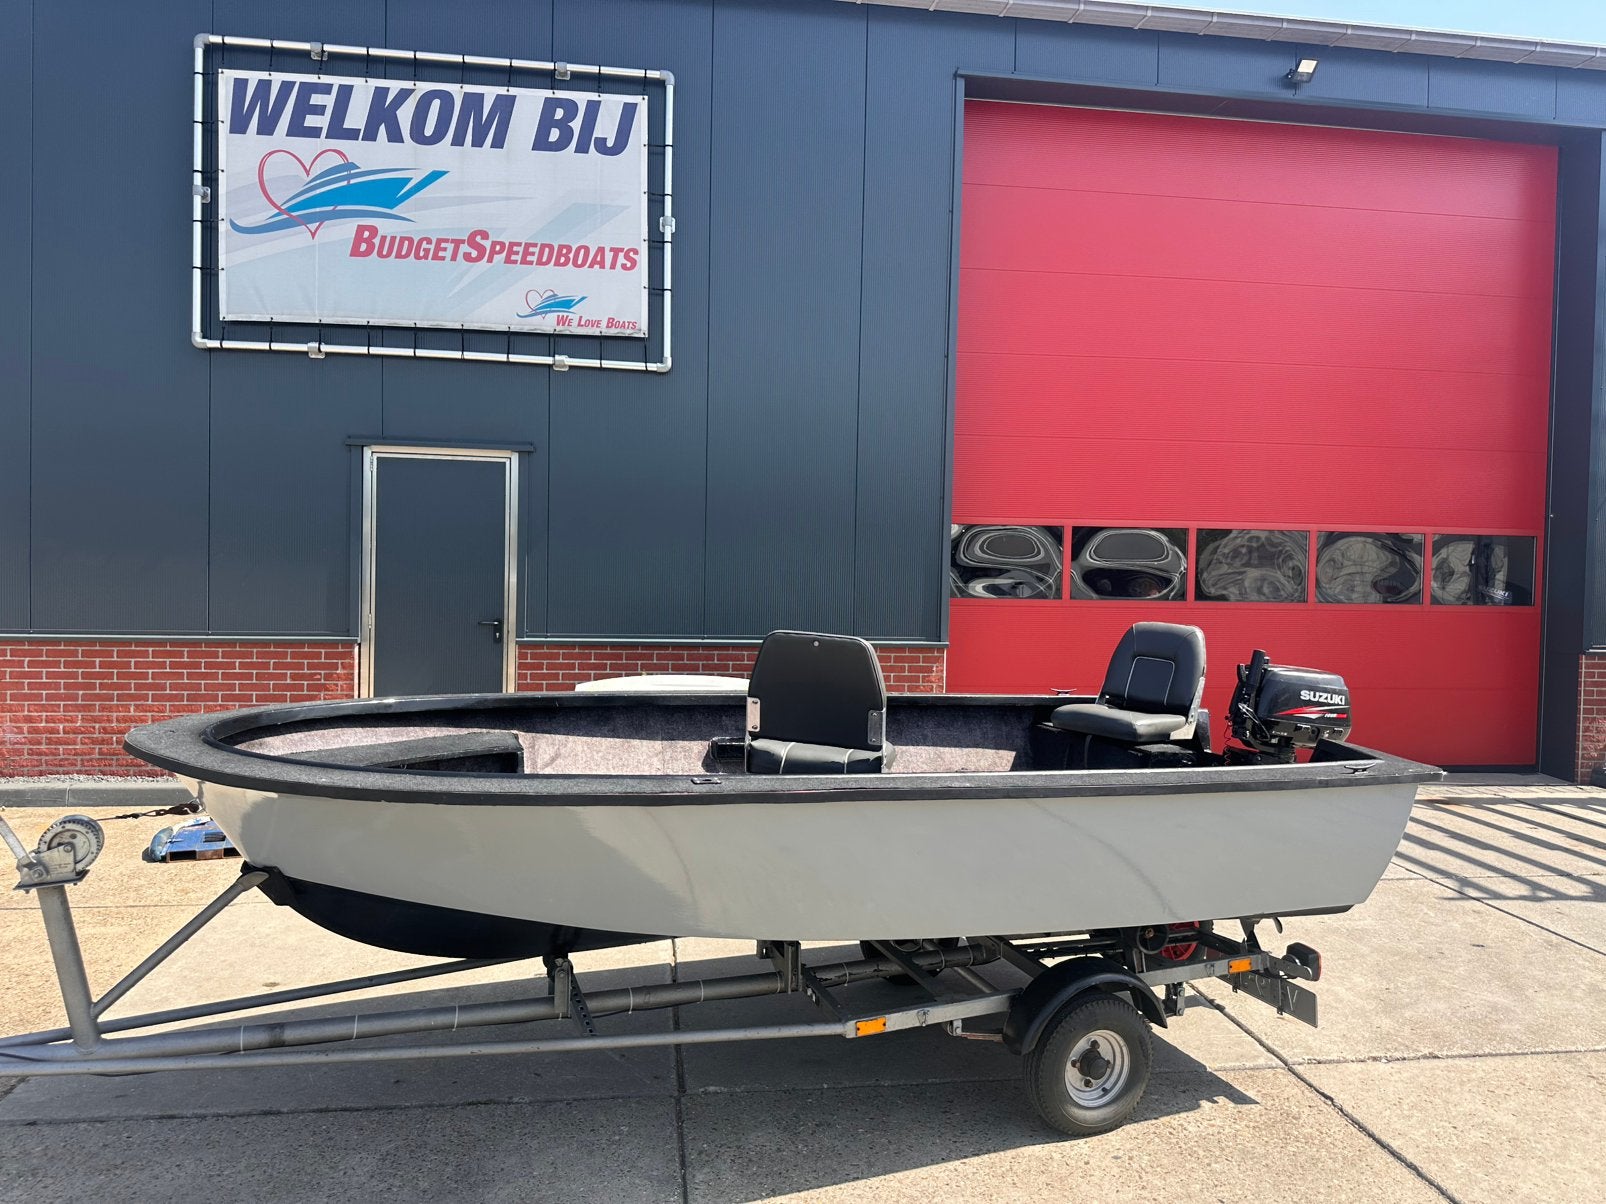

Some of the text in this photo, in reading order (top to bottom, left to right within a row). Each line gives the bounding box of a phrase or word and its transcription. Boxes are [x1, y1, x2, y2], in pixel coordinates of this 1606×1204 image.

[228, 77, 639, 157] WELKOM BIJ
[349, 224, 640, 272] BUDGETSPEEDBOATS
[556, 315, 638, 330] WE LOVE BOATS
[1300, 690, 1346, 705] SUZUKI
